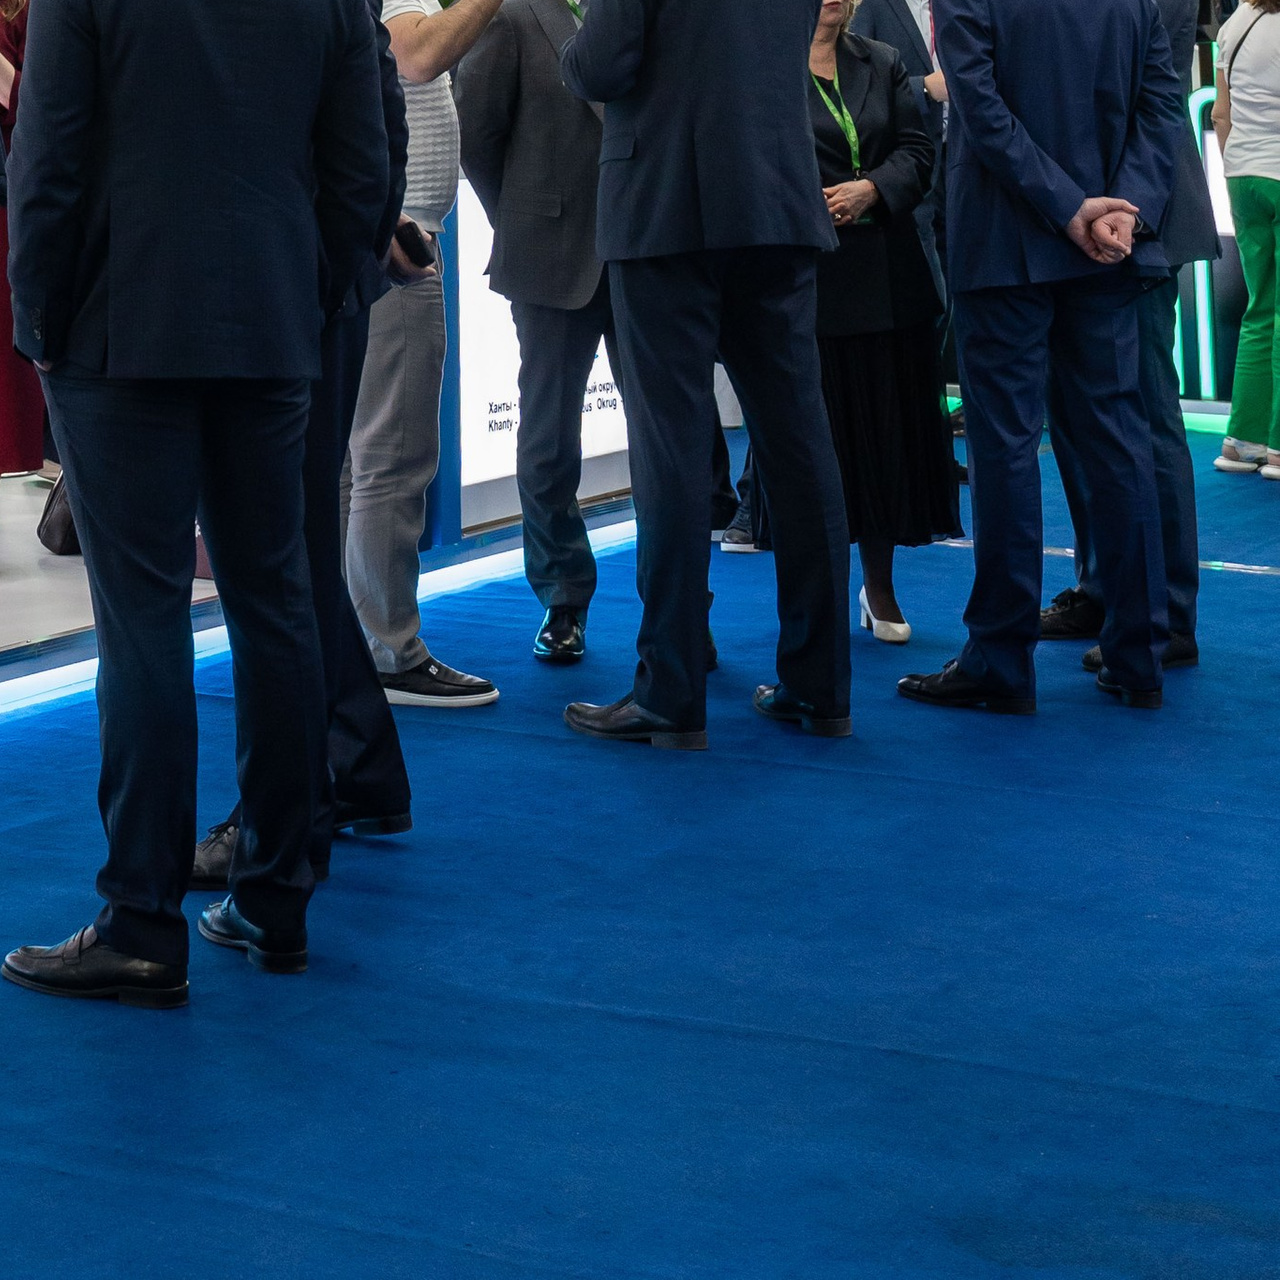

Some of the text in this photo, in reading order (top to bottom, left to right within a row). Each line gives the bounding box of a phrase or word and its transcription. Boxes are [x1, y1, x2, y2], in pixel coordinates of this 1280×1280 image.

[488, 401, 512, 414] Ханты
[488, 418, 513, 432] Khanty
[596, 398, 617, 411] Okrug
